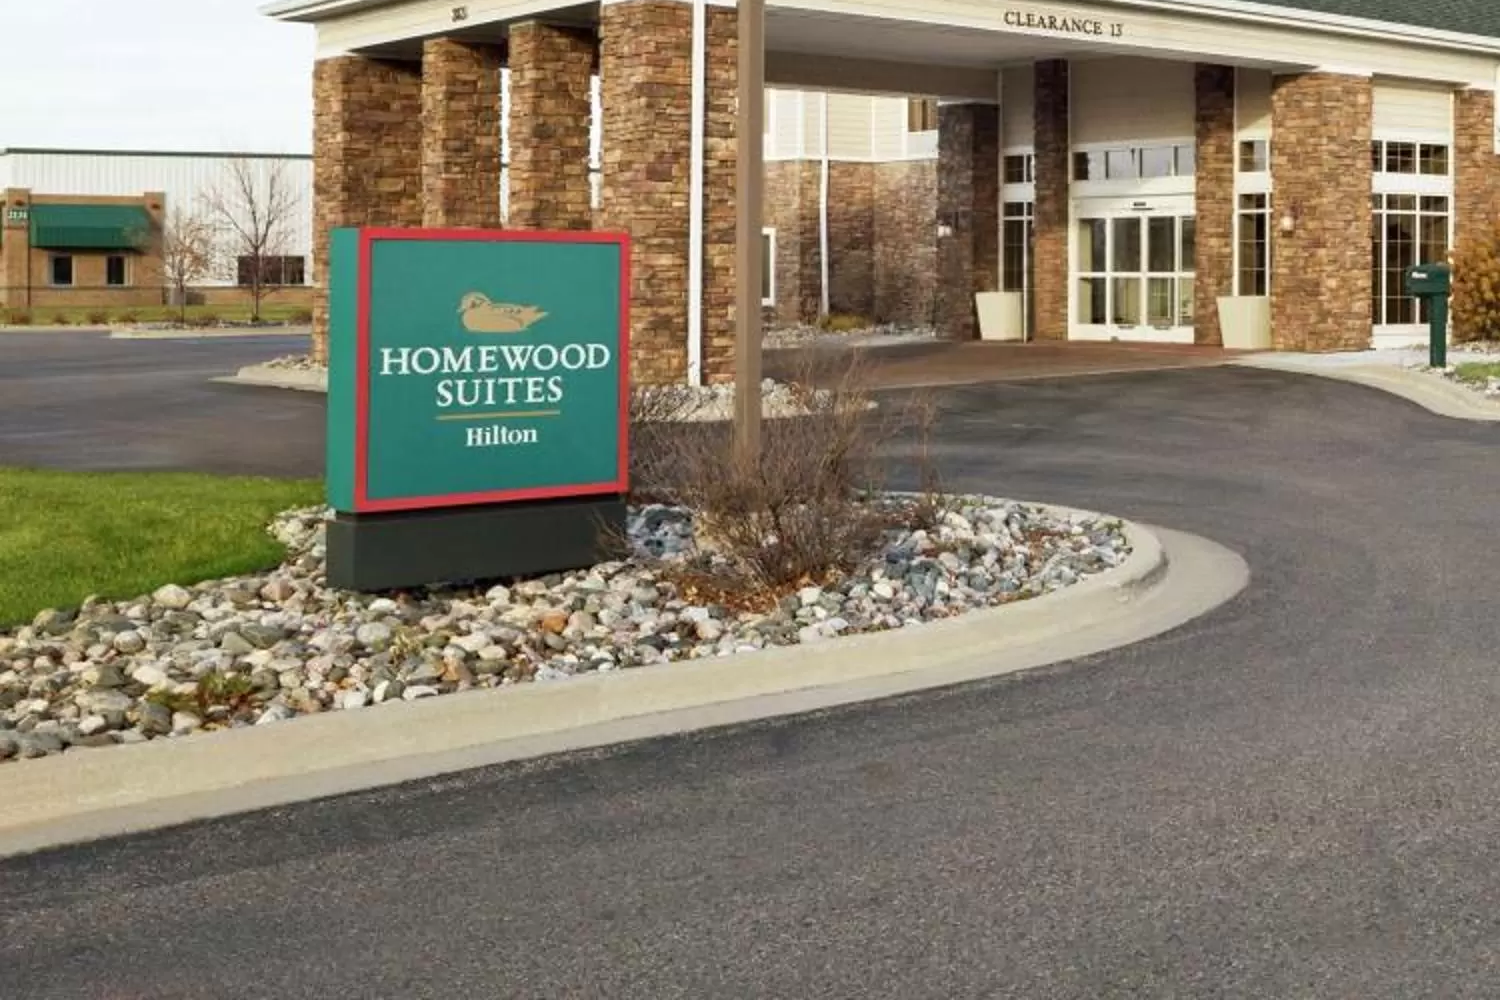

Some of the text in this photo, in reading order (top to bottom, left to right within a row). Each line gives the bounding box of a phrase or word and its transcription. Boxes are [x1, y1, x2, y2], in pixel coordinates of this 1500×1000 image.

[1004, 11, 1103, 35] CLEARANCE
[380, 344, 610, 375] HOMEWOOD
[436, 376, 563, 407] SUITES
[466, 425, 538, 447] Hilton
